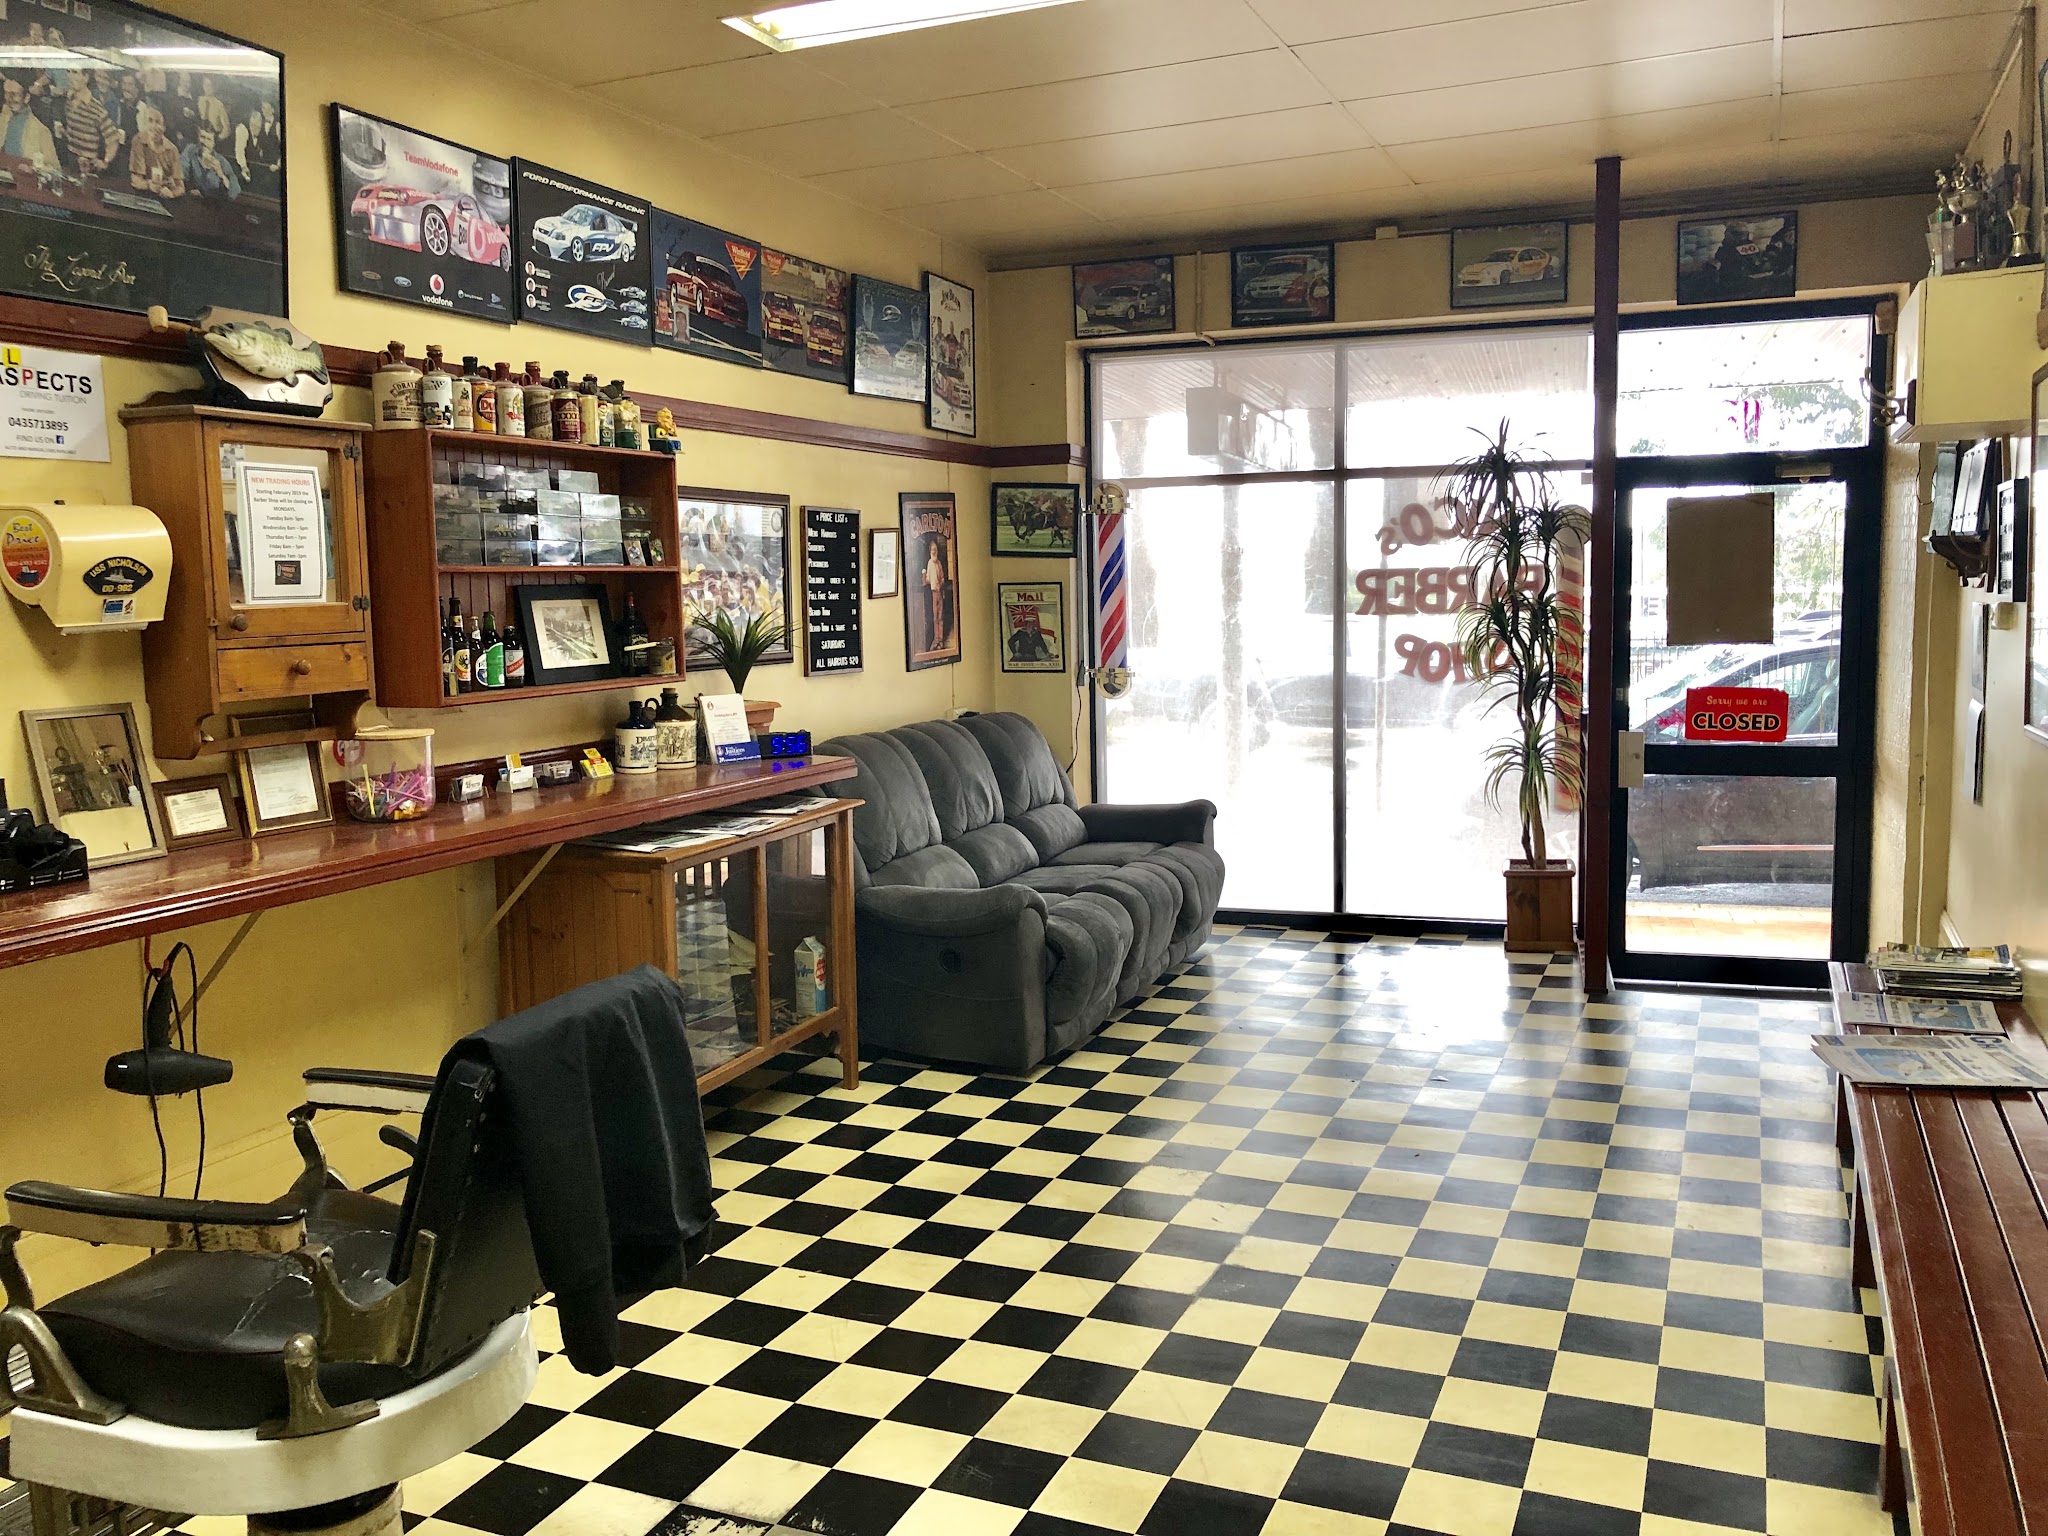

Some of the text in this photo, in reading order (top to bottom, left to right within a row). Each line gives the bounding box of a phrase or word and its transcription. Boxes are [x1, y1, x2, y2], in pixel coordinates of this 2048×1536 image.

[404, 151, 459, 177] TeamVodafone
[523, 171, 549, 185] FORD
[550, 180, 615, 206] PERFORMANCE
[615, 201, 646, 216] RACING
[422, 294, 454, 308] vodafone
[8, 417, 69, 431] 0435713895
[266, 477, 290, 485] TRADING
[820, 512, 833, 523] PRICE
[834, 513, 845, 523] LIST
[910, 512, 951, 538] CARLTON
[89, 558, 148, 578] USS NICHOLSON
[1016, 592, 1044, 602] Mail
[821, 639, 846, 650] SATURDAYS
[816, 655, 859, 668] ALL HAIRCUTS $20
[1706, 695, 1768, 707] Sorry we are
[1692, 711, 1781, 732] CLOSED
[771, 735, 807, 755] 9:56
